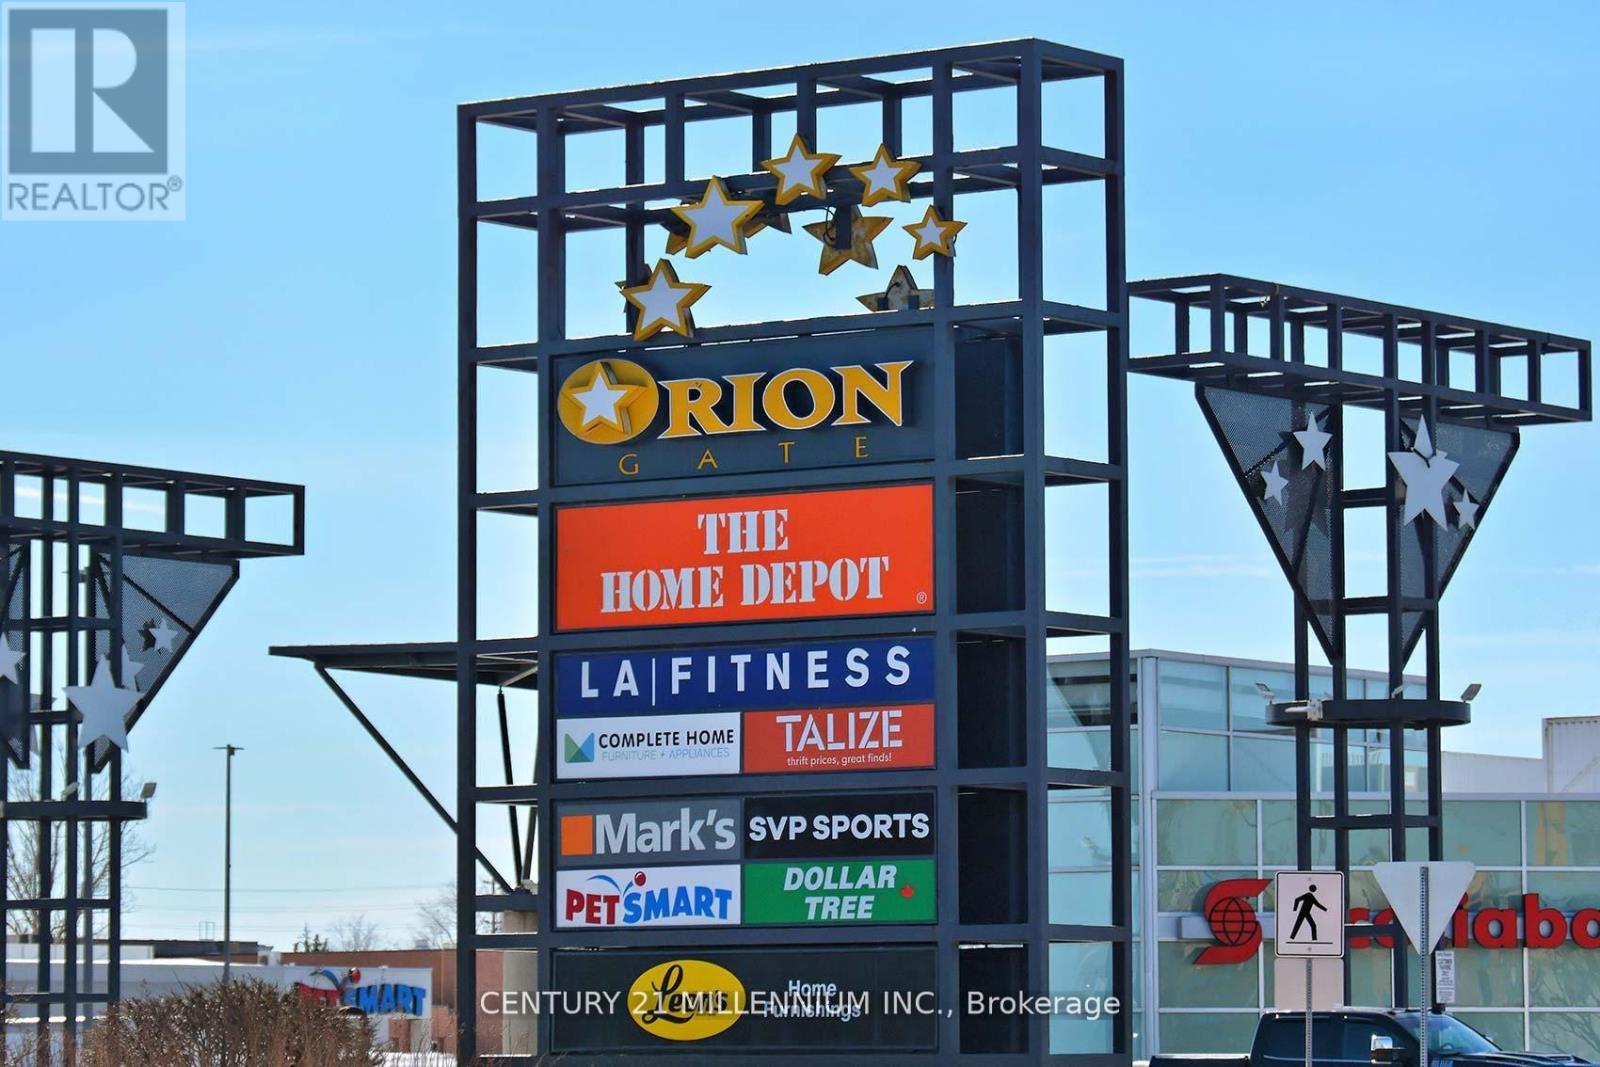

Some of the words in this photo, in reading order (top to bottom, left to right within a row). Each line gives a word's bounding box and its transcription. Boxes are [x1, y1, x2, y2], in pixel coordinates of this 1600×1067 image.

[557, 358, 914, 444] ORION
[618, 436, 869, 476] GATE
[697, 509, 789, 555] THE
[600, 566, 724, 613] HOME
[740, 556, 889, 605] DEPOT
[598, 731, 680, 749] COMPLETE
[686, 729, 735, 746] HOME
[776, 710, 903, 752] TALIZE
[602, 749, 657, 761] FURNITURE
[669, 747, 730, 759] APPLIANCES
[787, 756, 808, 766] thrift
[841, 755, 865, 767] great
[867, 753, 892, 764] finds!
[596, 808, 736, 855] Mark's
[749, 816, 807, 842] SVP
[813, 813, 930, 841] SPORTS
[783, 865, 897, 891] DOLLAR
[804, 895, 875, 920] TREE
[788, 980, 837, 998] Home
[764, 1001, 861, 1021] Furnishings
